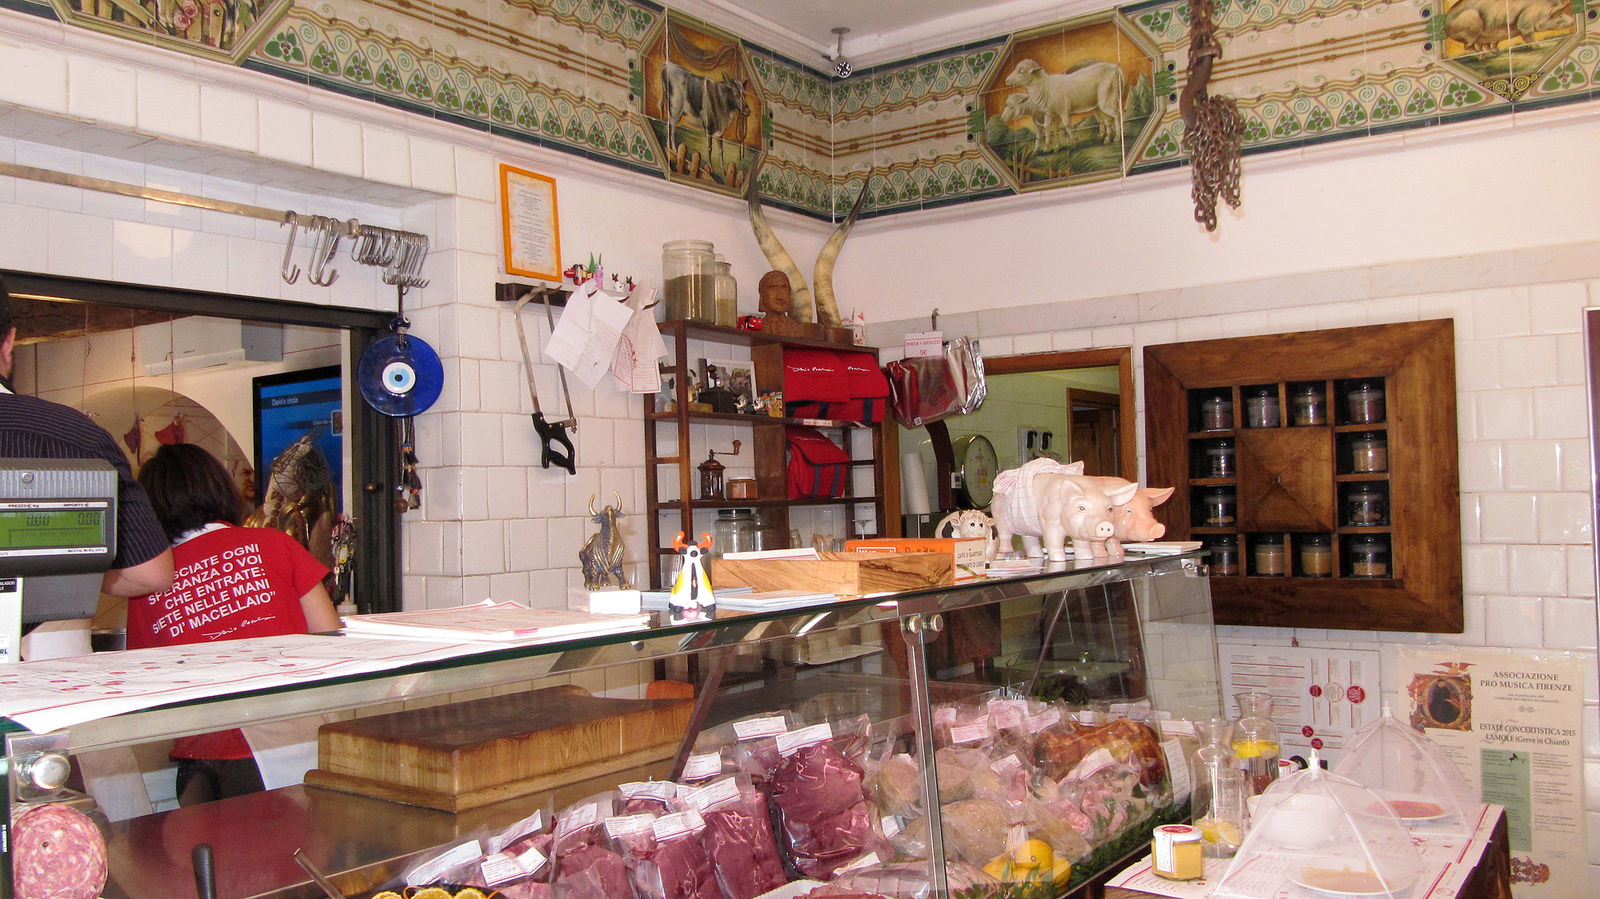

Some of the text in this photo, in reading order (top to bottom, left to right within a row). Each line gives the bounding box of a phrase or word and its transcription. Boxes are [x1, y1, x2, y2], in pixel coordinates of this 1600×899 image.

[222, 543, 260, 560] OGNI
[222, 562, 234, 573] O
[236, 554, 263, 568] VOI
[164, 566, 266, 610] CHE ENTRATE:
[152, 578, 271, 634] SIETE NELLE MANI
[1493, 671, 1559, 681] ASSOCIAZIONE
[1480, 680, 1573, 692] PRO MUSICA FIRENZE
[1480, 723, 1576, 737] ESTATE CONCERTISTICA 2015
[1515, 735, 1535, 744] (Greve
[1544, 738, 1570, 746] Chianti)
